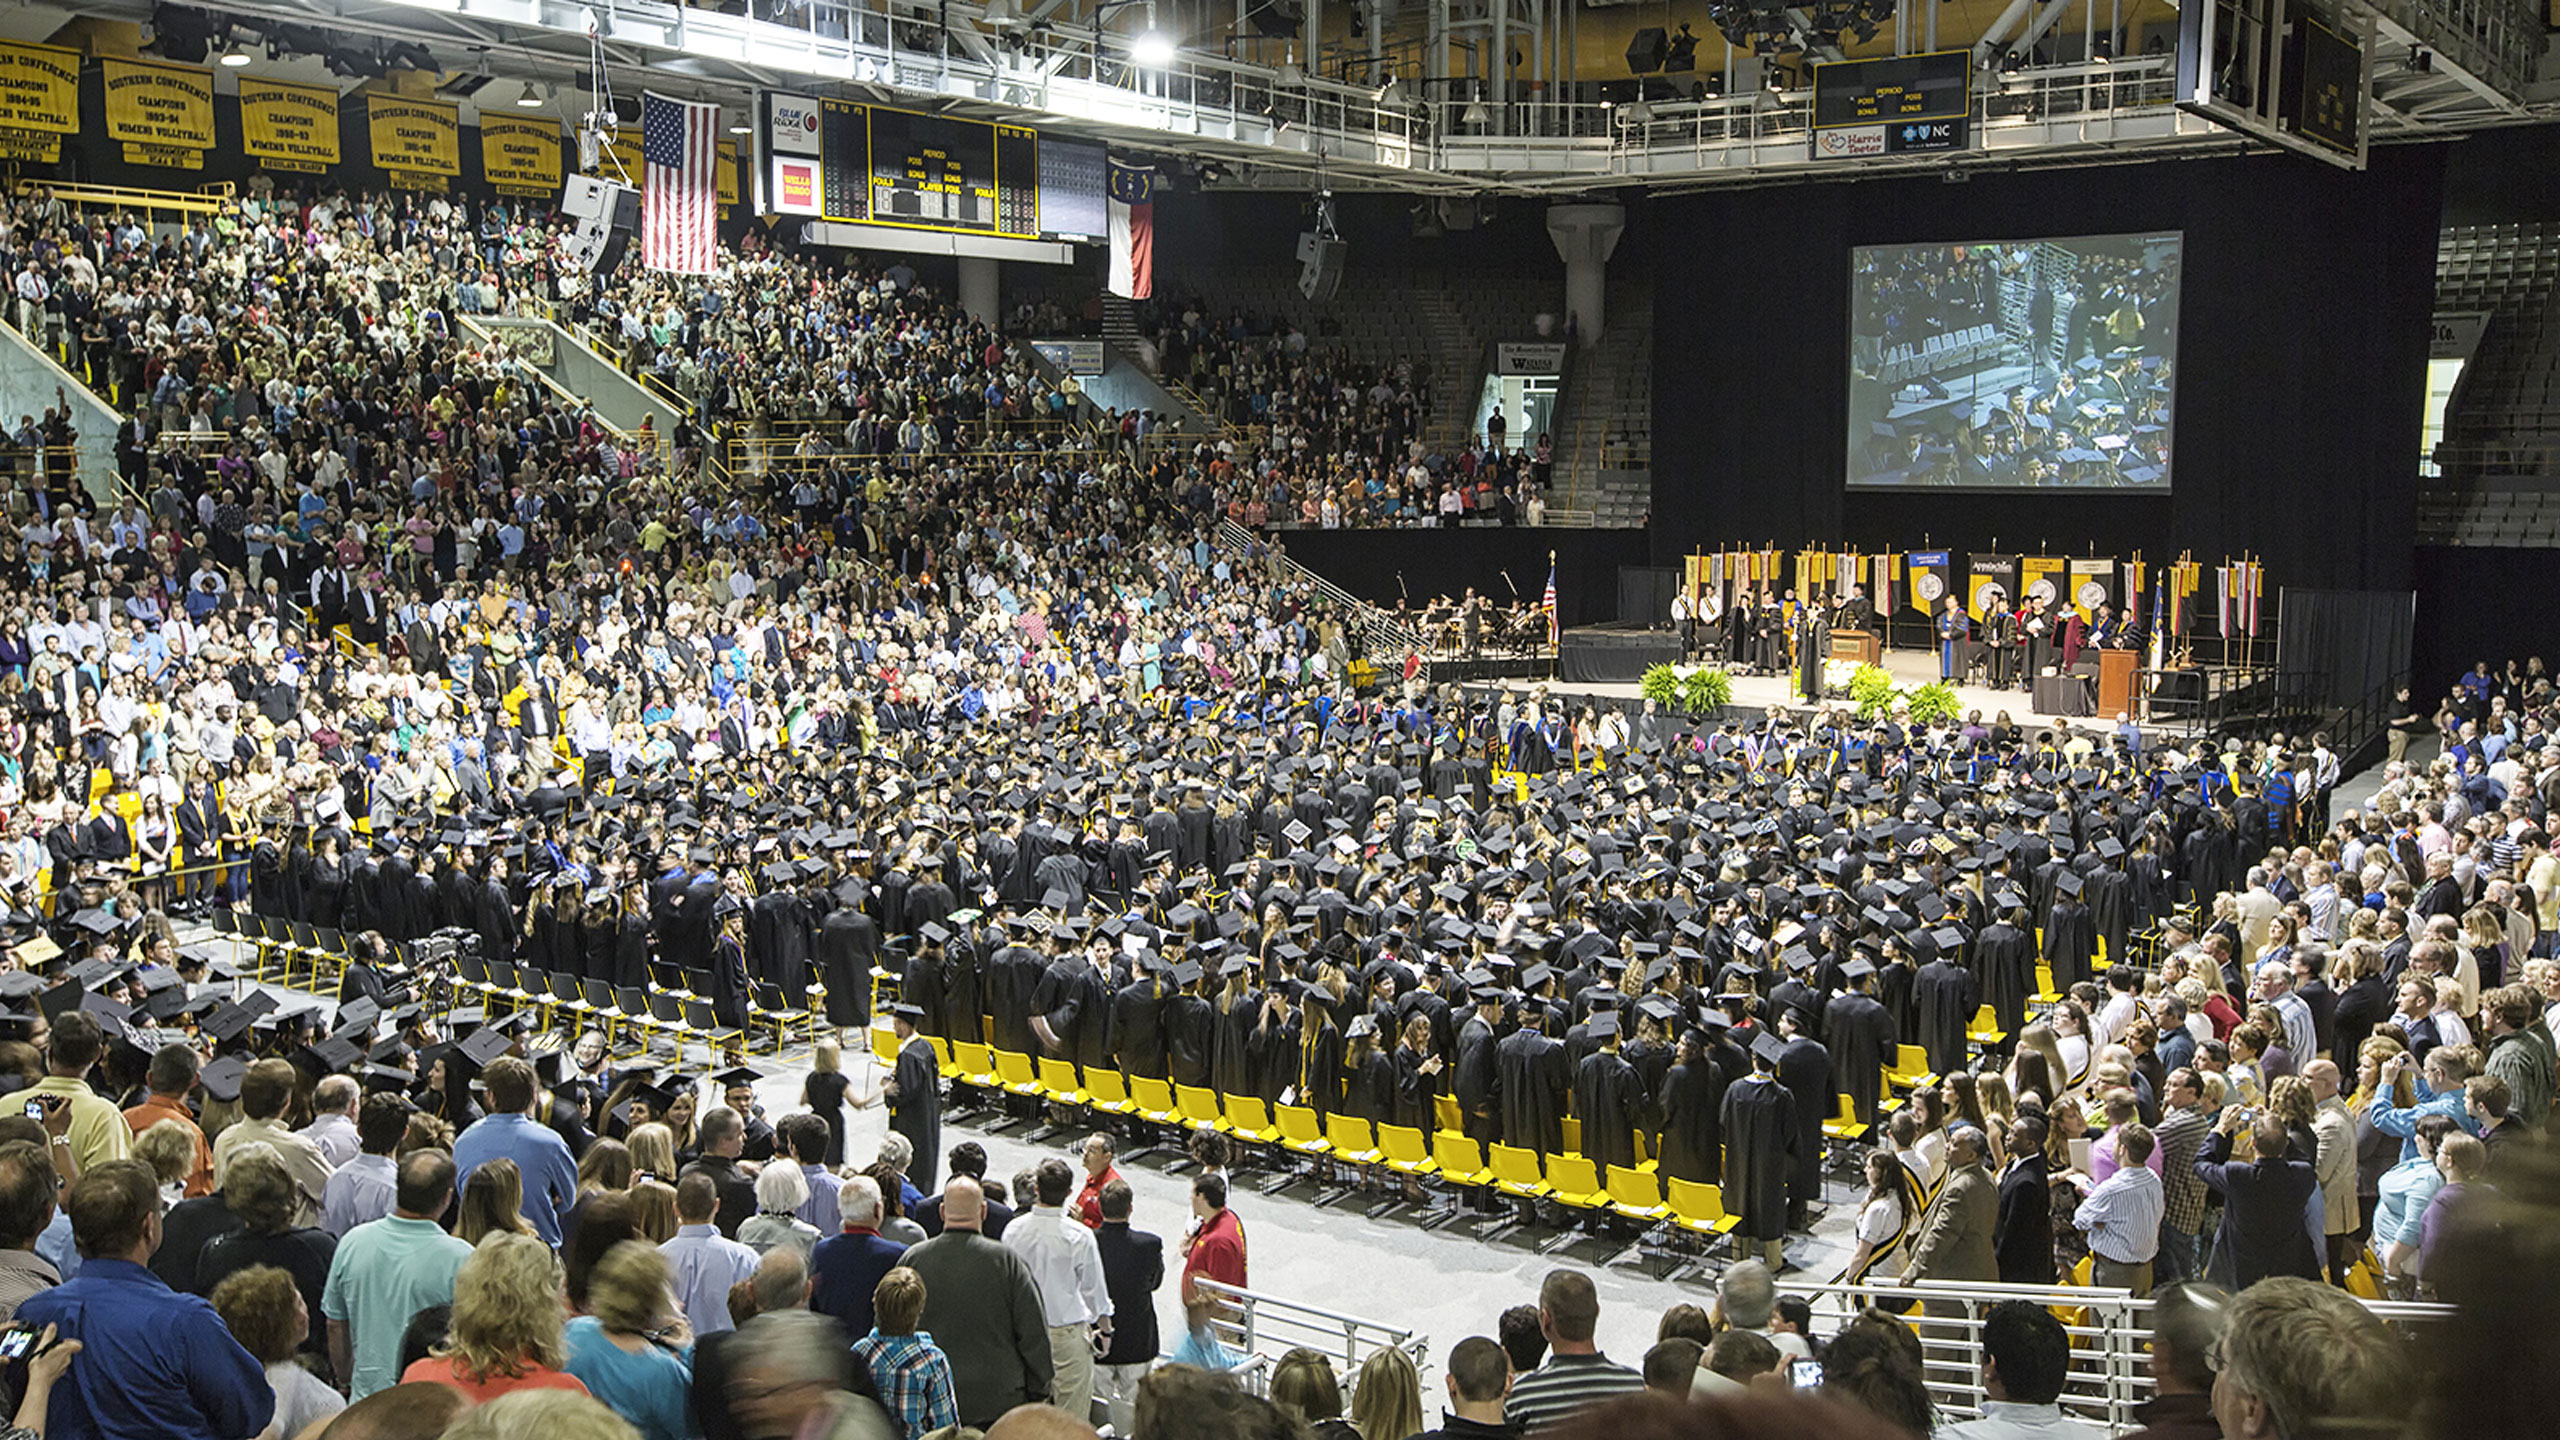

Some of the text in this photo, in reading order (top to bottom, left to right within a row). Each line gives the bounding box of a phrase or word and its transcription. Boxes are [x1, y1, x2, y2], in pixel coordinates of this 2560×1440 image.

[19, 56, 78, 85] CONFERENCE
[108, 75, 210, 104] SOUTHERN CONFERENCE
[1876, 86, 1903, 95] PERIOD
[137, 95, 187, 111] CHAMPIONS
[1857, 97, 1874, 105] POSS
[1905, 93, 1922, 101] POSS
[242, 92, 335, 117] SOUTHERN CONFERENCE
[1901, 103, 1922, 113] BONUS
[17, 110, 68, 125] VOLLEYBALL
[1857, 107, 1878, 116] BONUS
[268, 112, 314, 127] CHAMPIONS
[371, 107, 455, 131] SOUTHERN CONFERENCE
[117, 122, 207, 142] WOMENS VOLLEYBALL
[396, 127, 436, 141] CHAMPIONS
[482, 124, 558, 146] SOUTHERN CONFERENCE
[1932, 124, 1950, 137] NC
[1848, 133, 1882, 144] Harris
[250, 138, 334, 158] WOMENS VOLLEYBALL
[923, 148, 946, 160] PERIOD
[1848, 144, 1881, 154] Teeter
[907, 156, 922, 166] POSS
[947, 161, 961, 171] POSS
[784, 175, 811, 186] WELLS
[908, 169, 926, 180] BONUS
[944, 173, 962, 184] BONUS
[873, 176, 894, 187] FOULS
[785, 185, 811, 197] FARGO
[918, 181, 961, 195] PLAYER FOUL
[974, 187, 994, 199] FOULS
[2440, 325, 2455, 341] Co.
